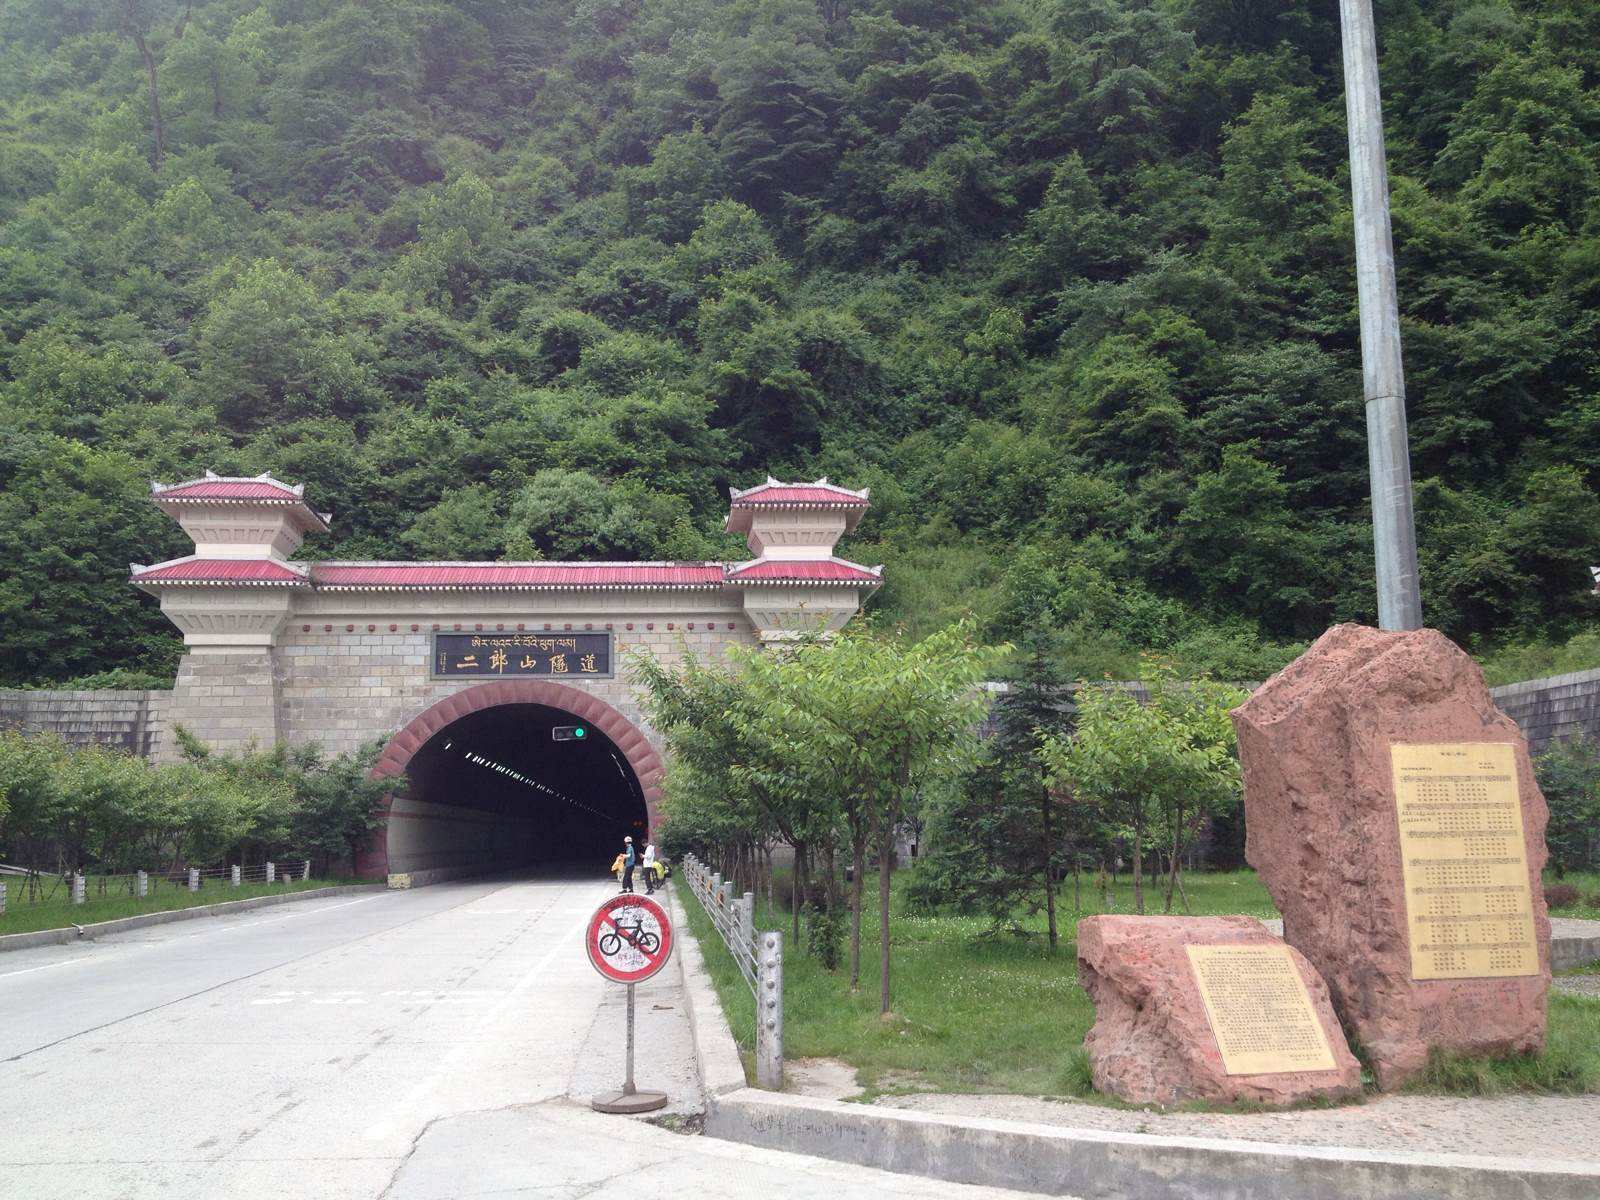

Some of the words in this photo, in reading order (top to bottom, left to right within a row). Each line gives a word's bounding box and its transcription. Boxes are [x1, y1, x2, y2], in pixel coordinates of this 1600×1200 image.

[456, 649, 599, 674] 二郎山隧道
